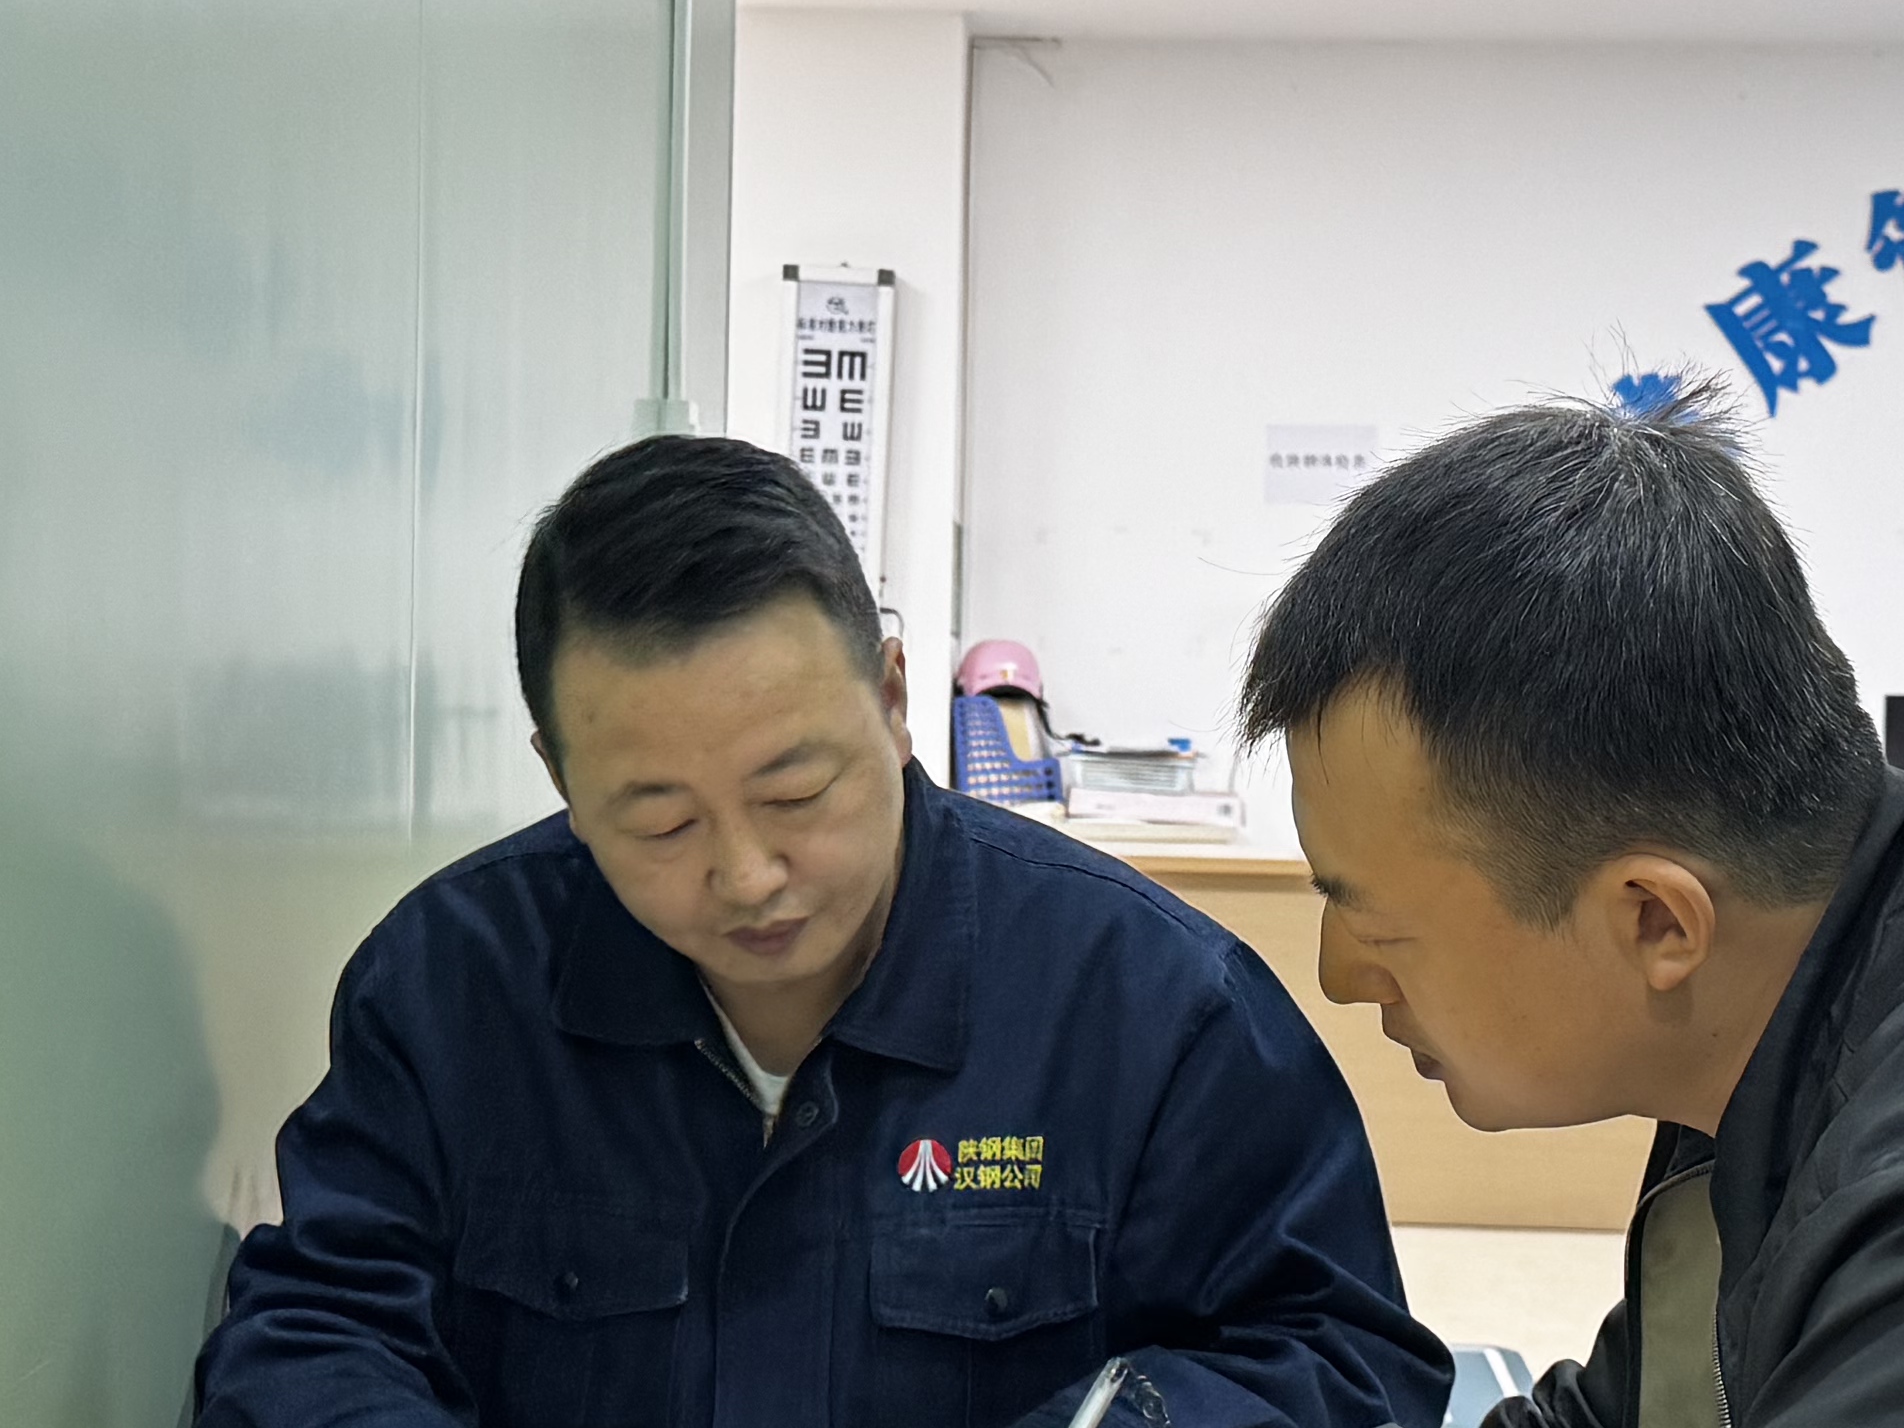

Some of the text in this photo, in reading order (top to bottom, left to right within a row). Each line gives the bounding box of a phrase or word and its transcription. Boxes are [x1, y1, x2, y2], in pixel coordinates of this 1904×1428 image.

[958, 1135, 1044, 1164] 陕钢集团
[953, 1163, 1043, 1191] 汉钢公司
